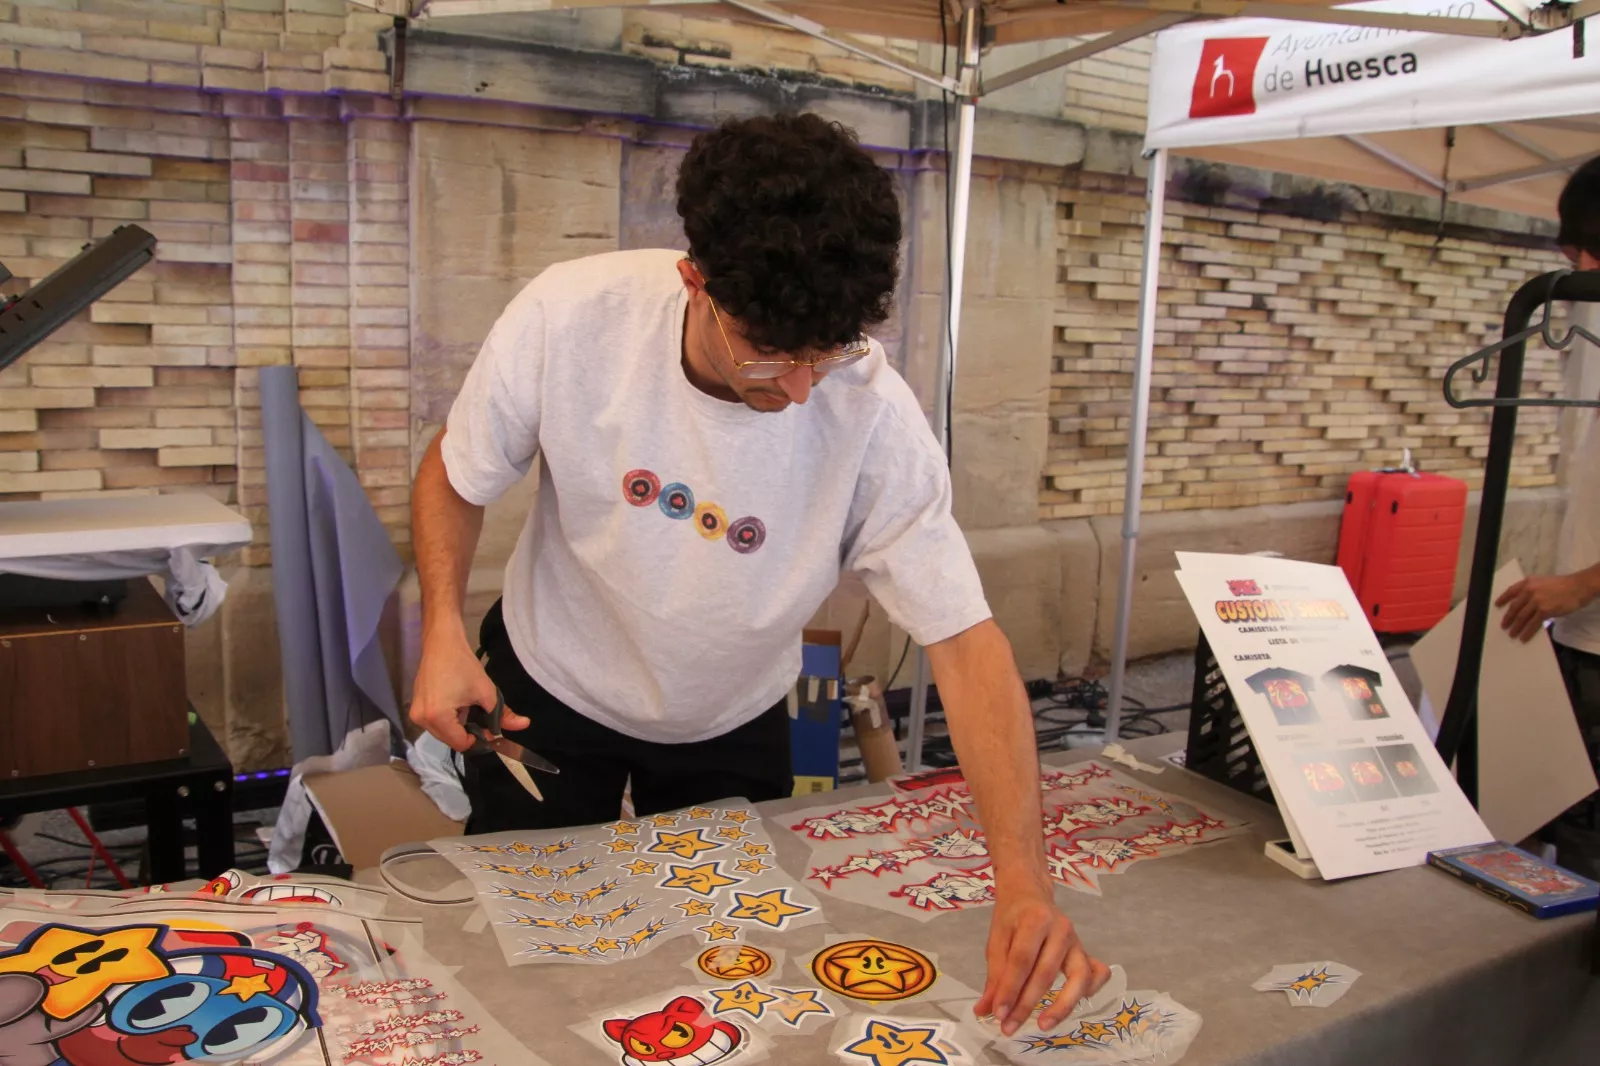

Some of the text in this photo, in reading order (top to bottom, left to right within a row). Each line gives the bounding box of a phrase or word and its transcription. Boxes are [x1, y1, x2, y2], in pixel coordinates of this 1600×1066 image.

[1264, 52, 1417, 92] de Huesca
[1215, 599, 1285, 623] CUSTOM
[1234, 653, 1272, 661] CAMISETA
